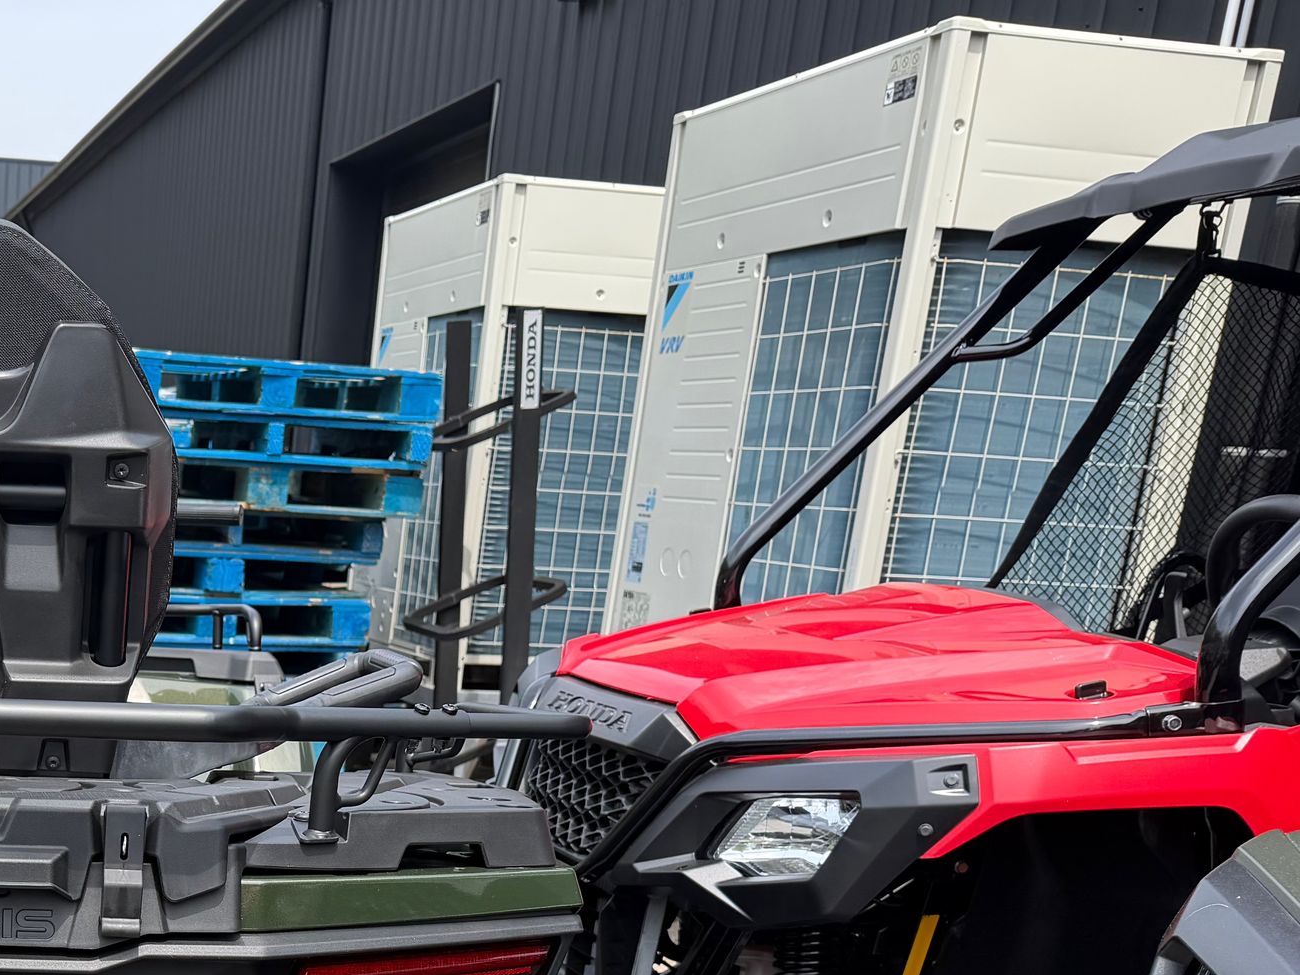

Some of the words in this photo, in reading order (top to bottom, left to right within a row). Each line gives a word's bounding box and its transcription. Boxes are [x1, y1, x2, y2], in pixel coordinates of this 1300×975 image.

[668, 271, 695, 283] DAIKIN
[524, 319, 538, 400] HONDA
[659, 335, 685, 354] VRV
[548, 690, 633, 733] HONDA
